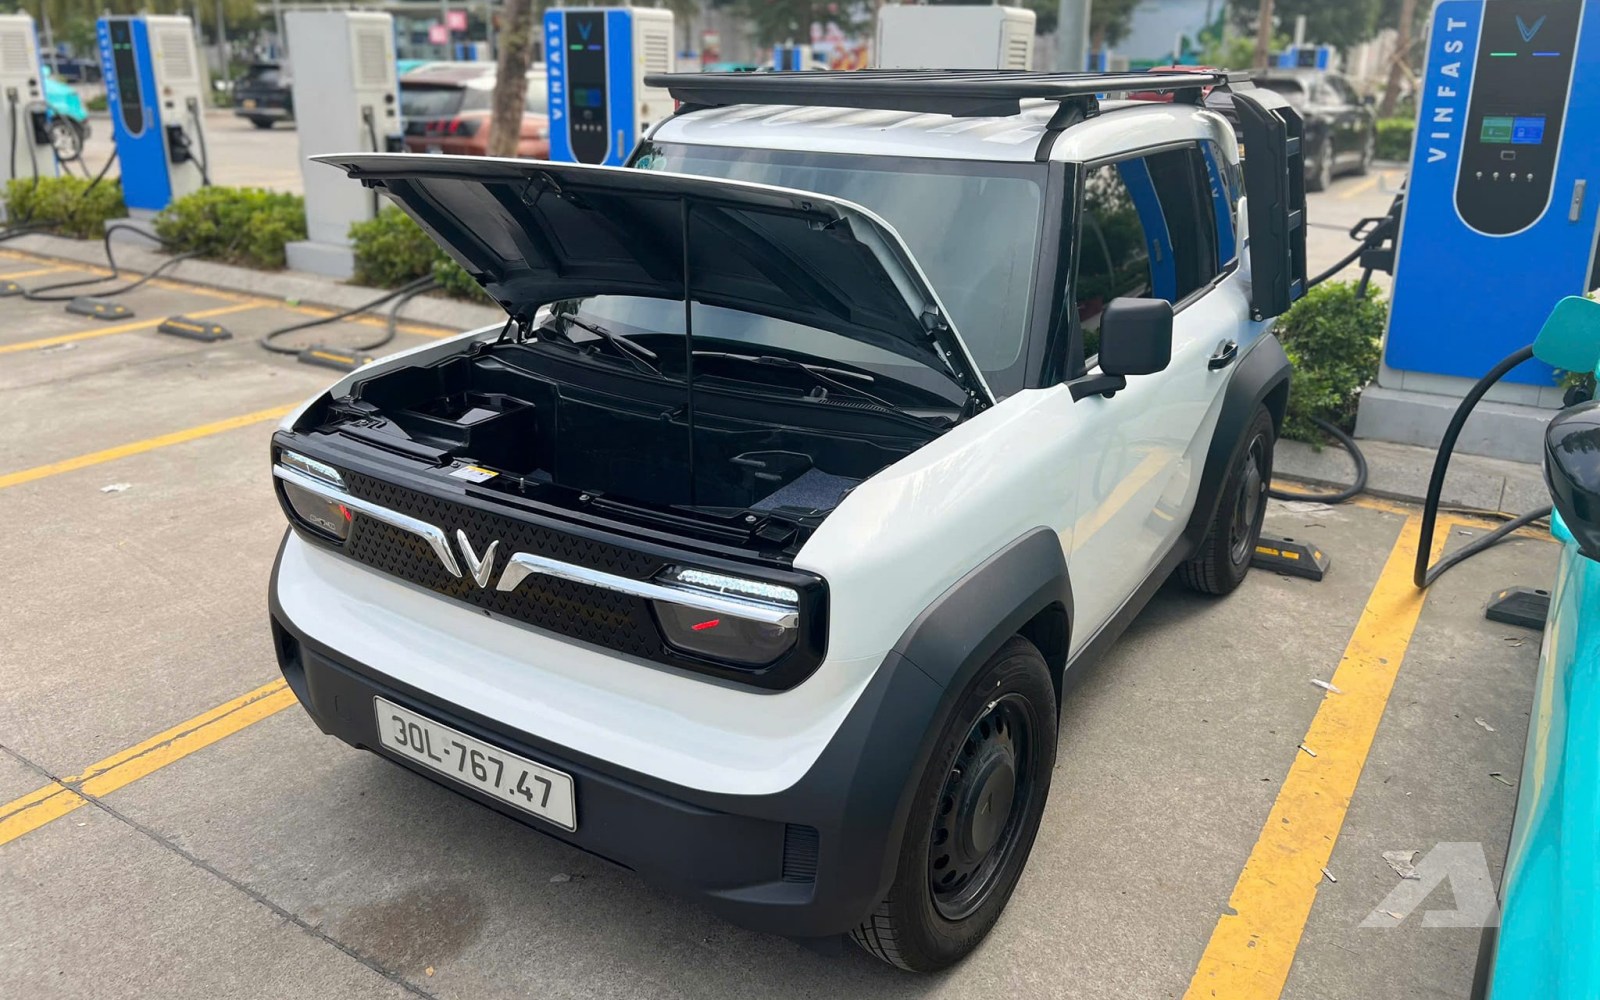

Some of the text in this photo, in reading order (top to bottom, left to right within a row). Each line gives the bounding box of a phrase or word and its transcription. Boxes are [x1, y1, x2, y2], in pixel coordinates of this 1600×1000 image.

[548, 22, 562, 120] VINFAST
[1427, 17, 1467, 163] VINFAST
[392, 715, 552, 808] 30L-767.47
